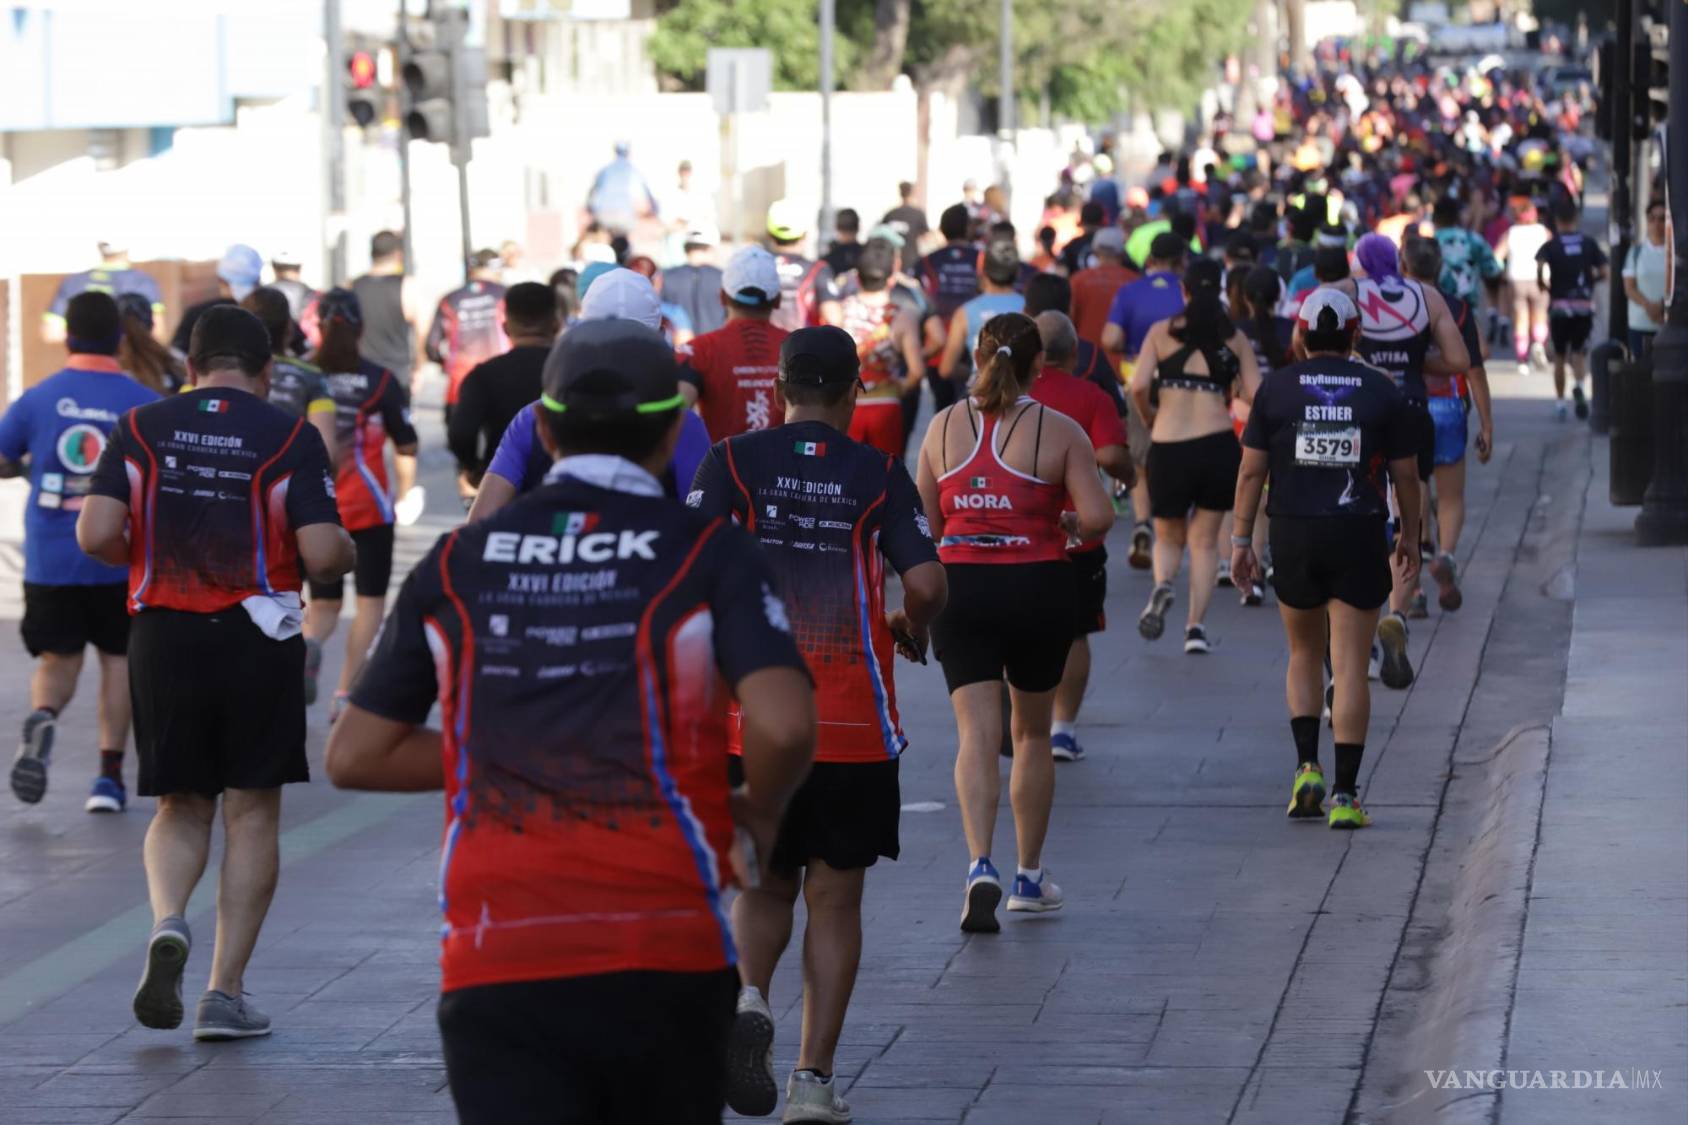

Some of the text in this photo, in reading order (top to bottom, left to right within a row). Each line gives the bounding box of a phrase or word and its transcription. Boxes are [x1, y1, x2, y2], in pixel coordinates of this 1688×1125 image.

[1305, 405, 1353, 421] ESTHER
[174, 430, 243, 448] XXVI EDICIÓN
[1304, 437, 1353, 456] 3579
[953, 494, 1013, 510] NORA
[483, 530, 660, 564] ERICK
[508, 572, 548, 592] XXVI
